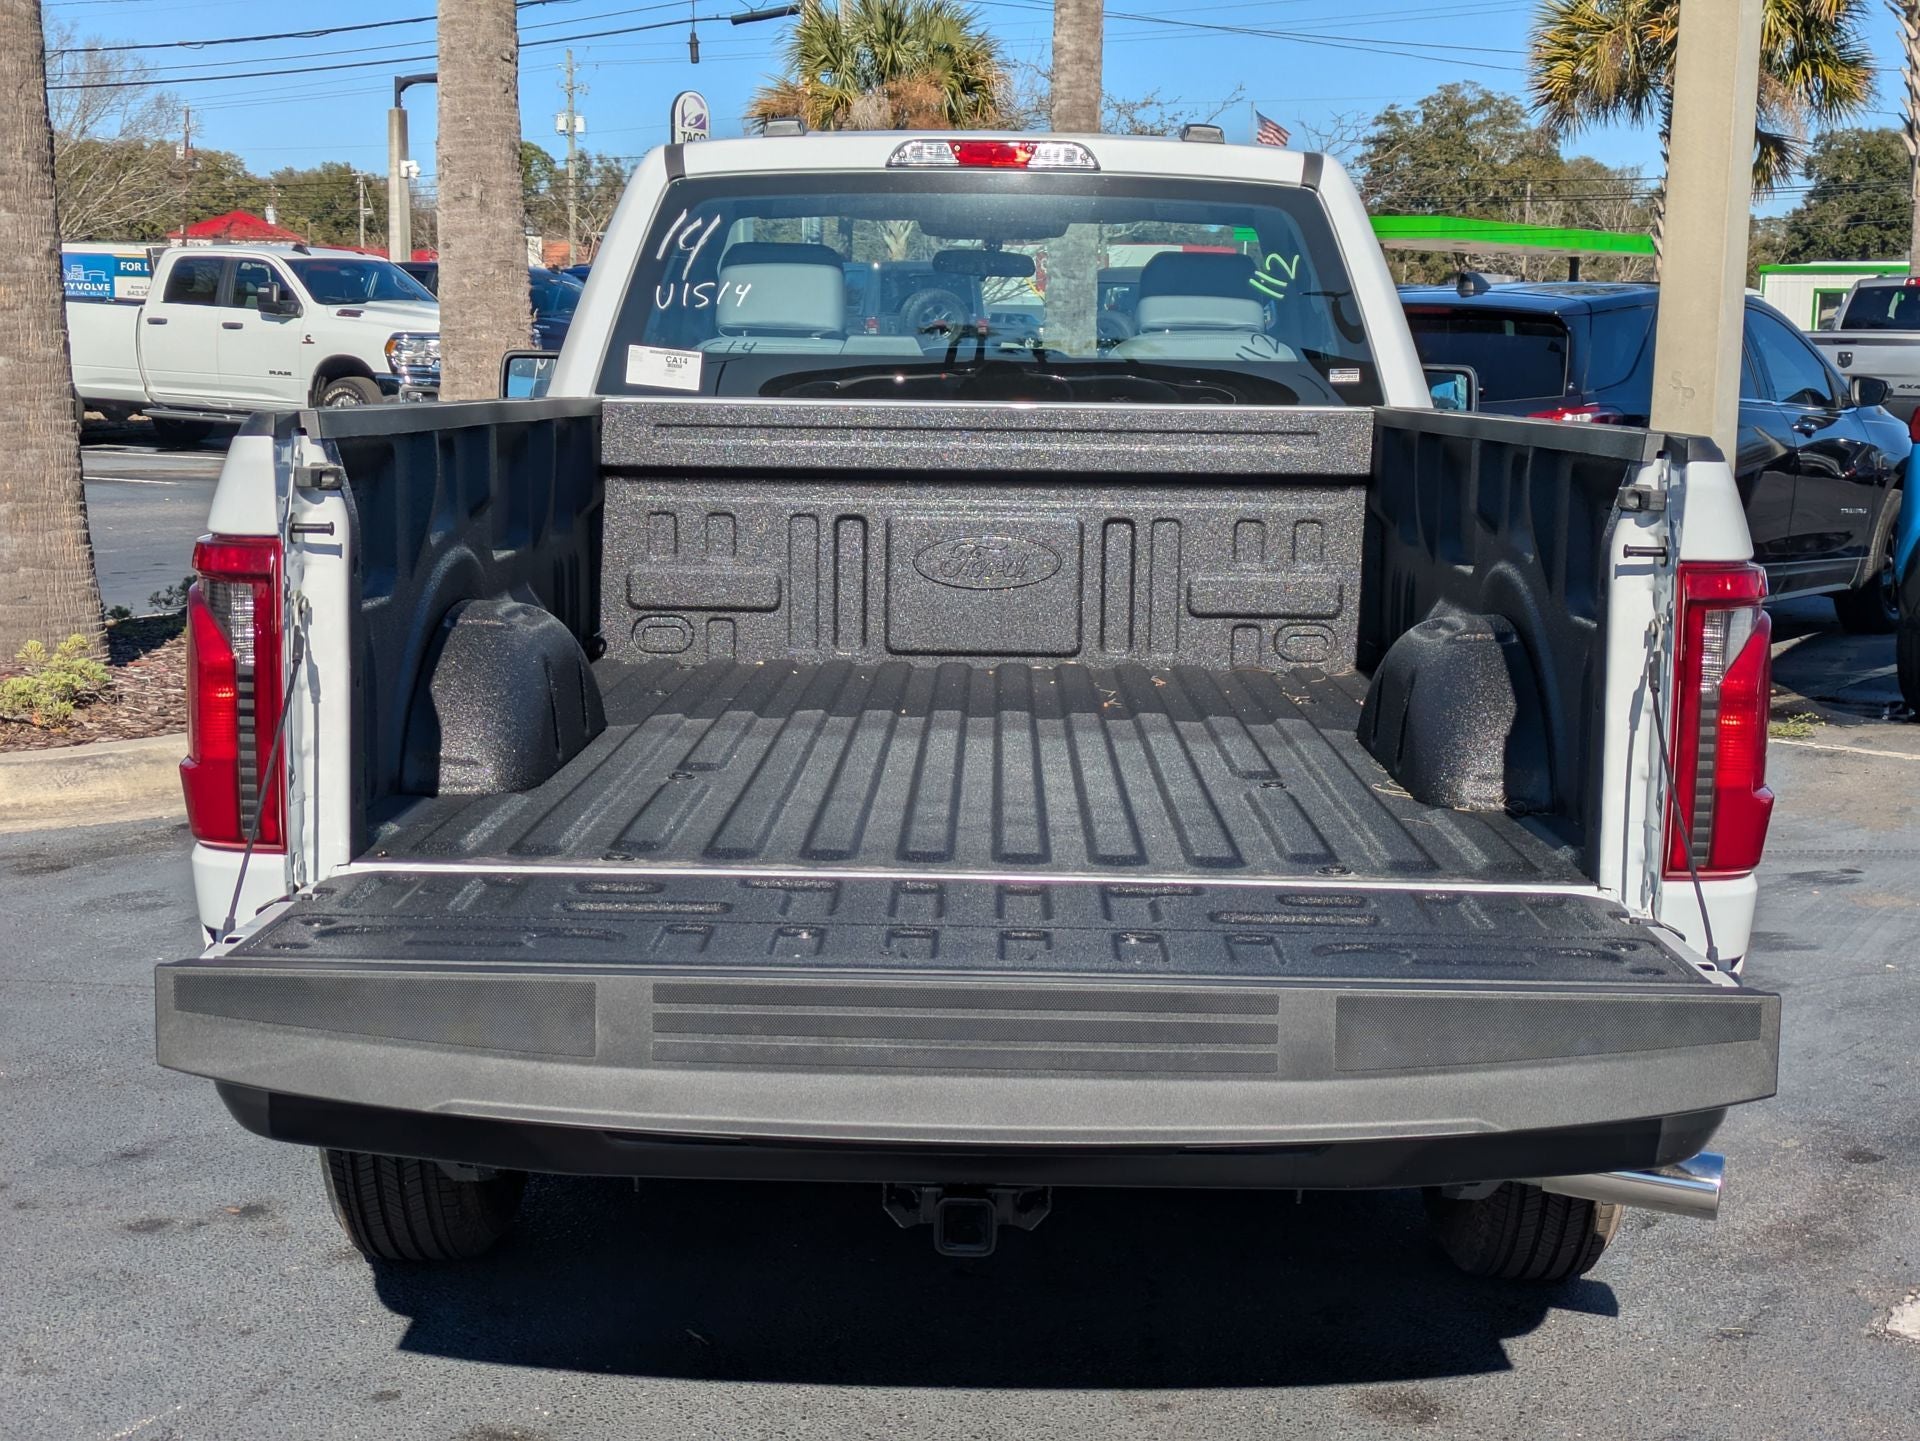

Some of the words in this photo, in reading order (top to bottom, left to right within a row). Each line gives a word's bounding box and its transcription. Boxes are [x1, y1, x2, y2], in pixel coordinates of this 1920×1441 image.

[681, 131, 706, 143] TACO
[656, 208, 720, 280] 14
[120, 262, 142, 271] FOR
[1249, 253, 1300, 299] 112
[665, 356, 688, 365] CA14
[268, 369, 292, 377] RAM
[940, 543, 1030, 579] Ford
